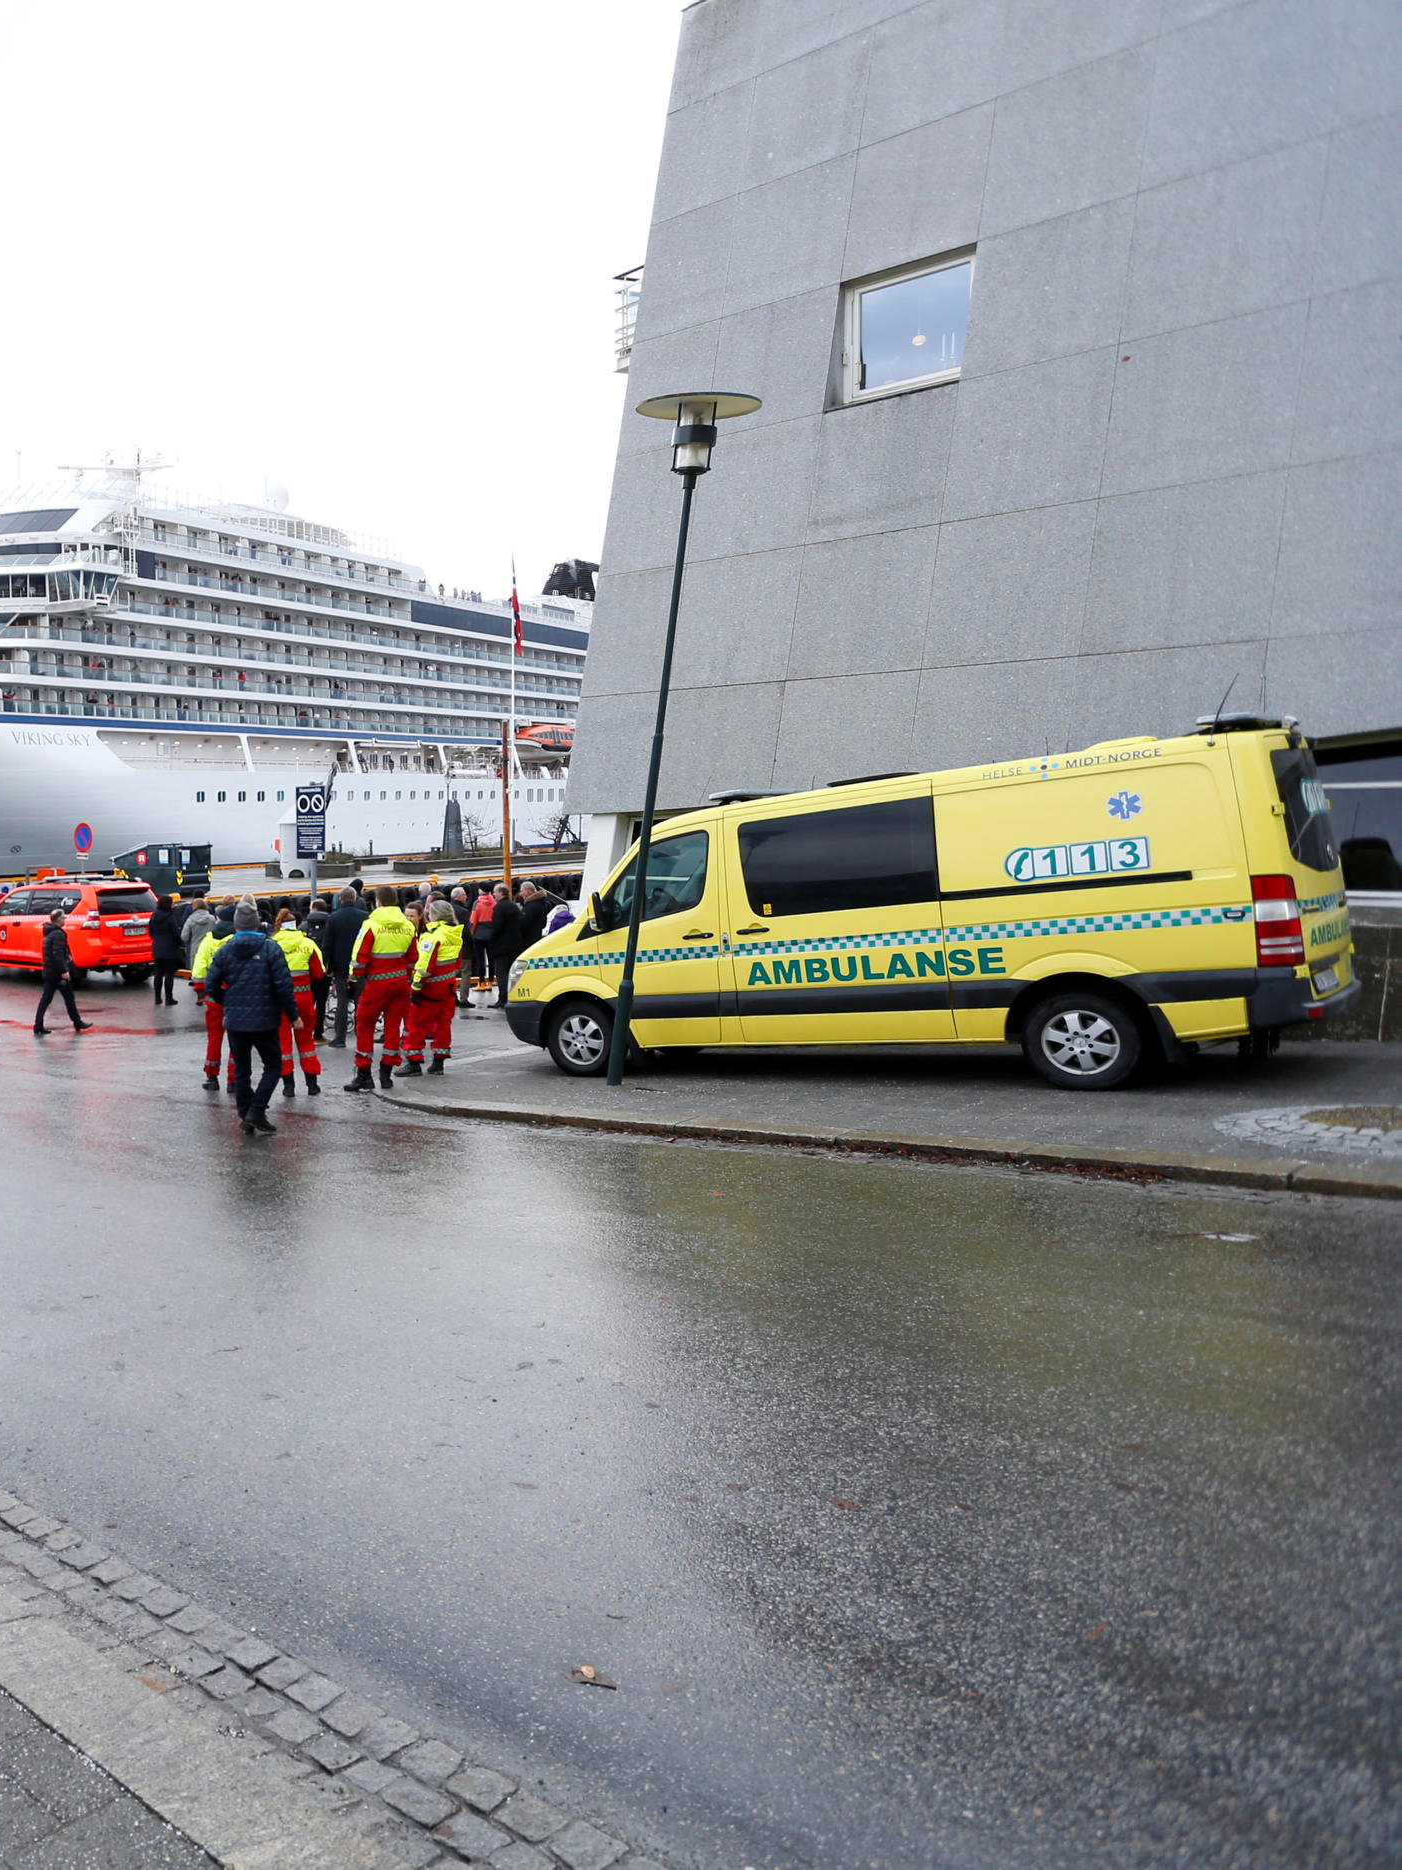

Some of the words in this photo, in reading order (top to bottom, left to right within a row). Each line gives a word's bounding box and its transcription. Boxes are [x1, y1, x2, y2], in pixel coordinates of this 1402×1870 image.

[11, 731, 63, 746] VIKING
[66, 733, 90, 746] SKY
[982, 766, 1023, 780] HELSE
[1065, 748, 1163, 769] MIDT-NORGE
[1042, 841, 1141, 875] 113
[747, 947, 1006, 986] AMBULANSE
[518, 988, 531, 998] M1
